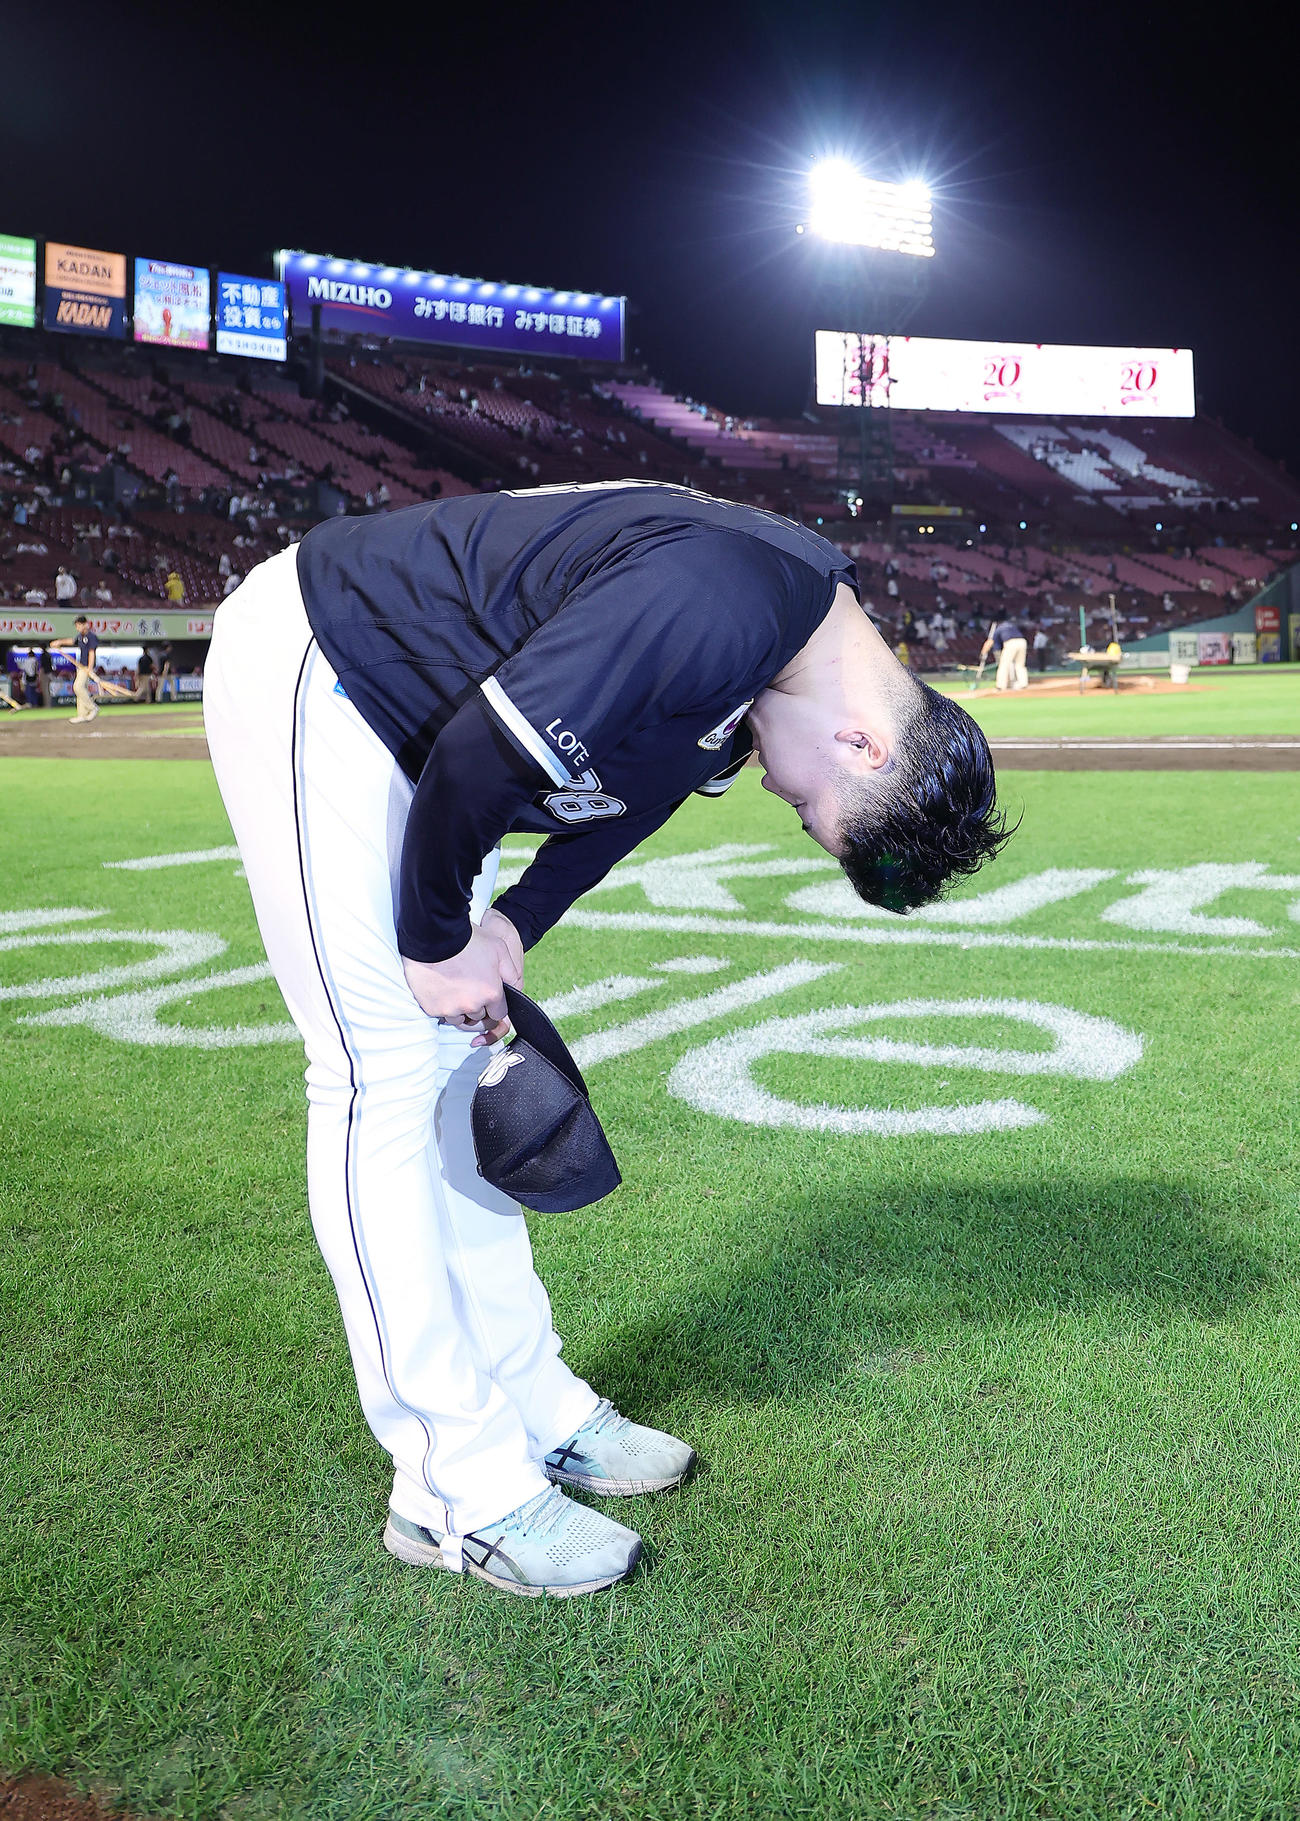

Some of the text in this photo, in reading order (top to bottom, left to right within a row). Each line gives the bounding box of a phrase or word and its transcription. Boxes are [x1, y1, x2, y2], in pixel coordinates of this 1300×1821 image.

[57, 259, 112, 279] KADAN
[222, 282, 280, 308] 不動産
[308, 276, 393, 309] MIZUHO
[56, 300, 113, 329] KADAN
[414, 296, 601, 339] みずほ銀行 みずほ証券
[984, 361, 1021, 387] 20
[1120, 366, 1157, 392] 20
[0, 619, 54, 634] リマハム
